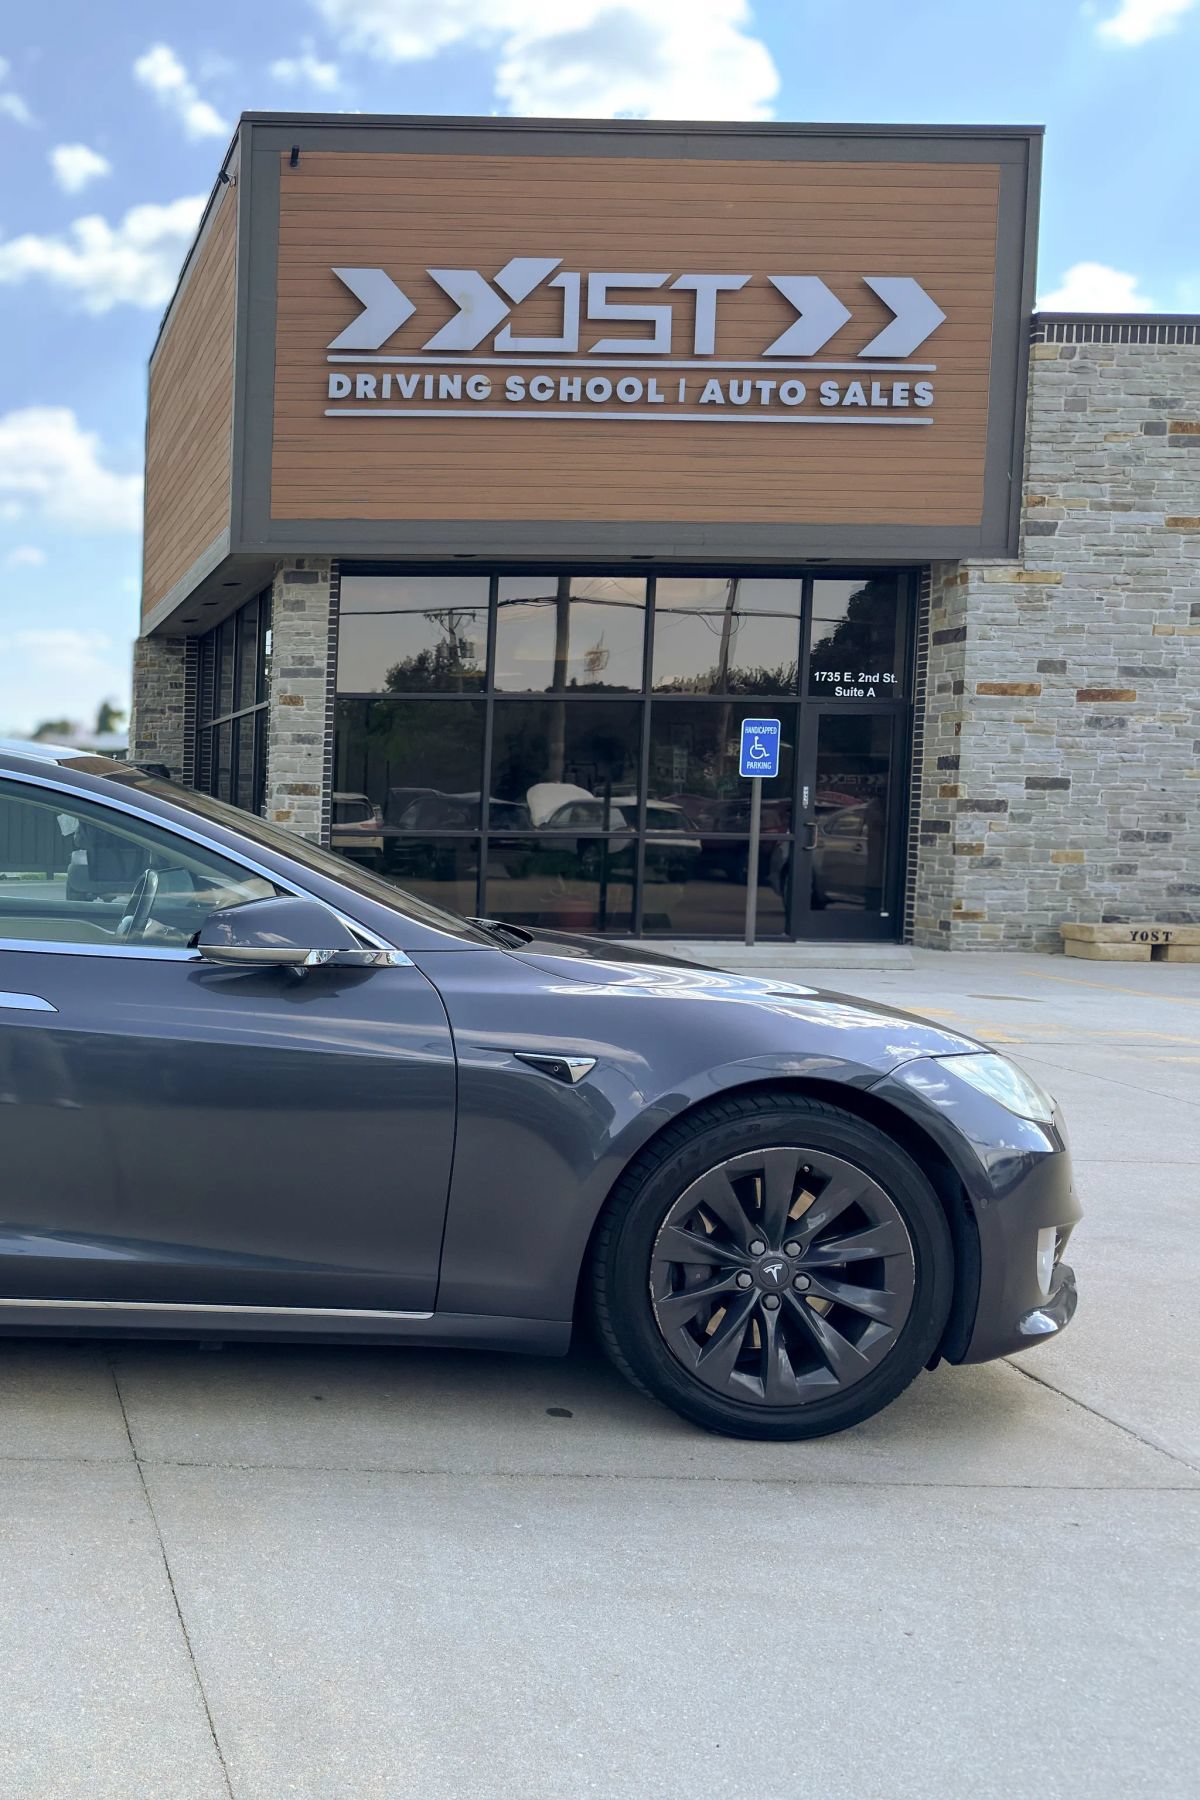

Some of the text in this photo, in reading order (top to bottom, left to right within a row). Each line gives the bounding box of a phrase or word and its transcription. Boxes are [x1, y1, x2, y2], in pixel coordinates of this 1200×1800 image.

[327, 372, 492, 401] DRIVING
[505, 375, 665, 404] SCHOOL
[699, 379, 807, 406] AUTO
[819, 381, 935, 408] SALES
[814, 671, 898, 683] 1735 E. 2nd St.
[834, 686, 876, 697] Suite A
[745, 726, 777, 735] HANDICAPPED
[746, 761, 772, 769] PARKING
[1129, 930, 1172, 942] YOST
